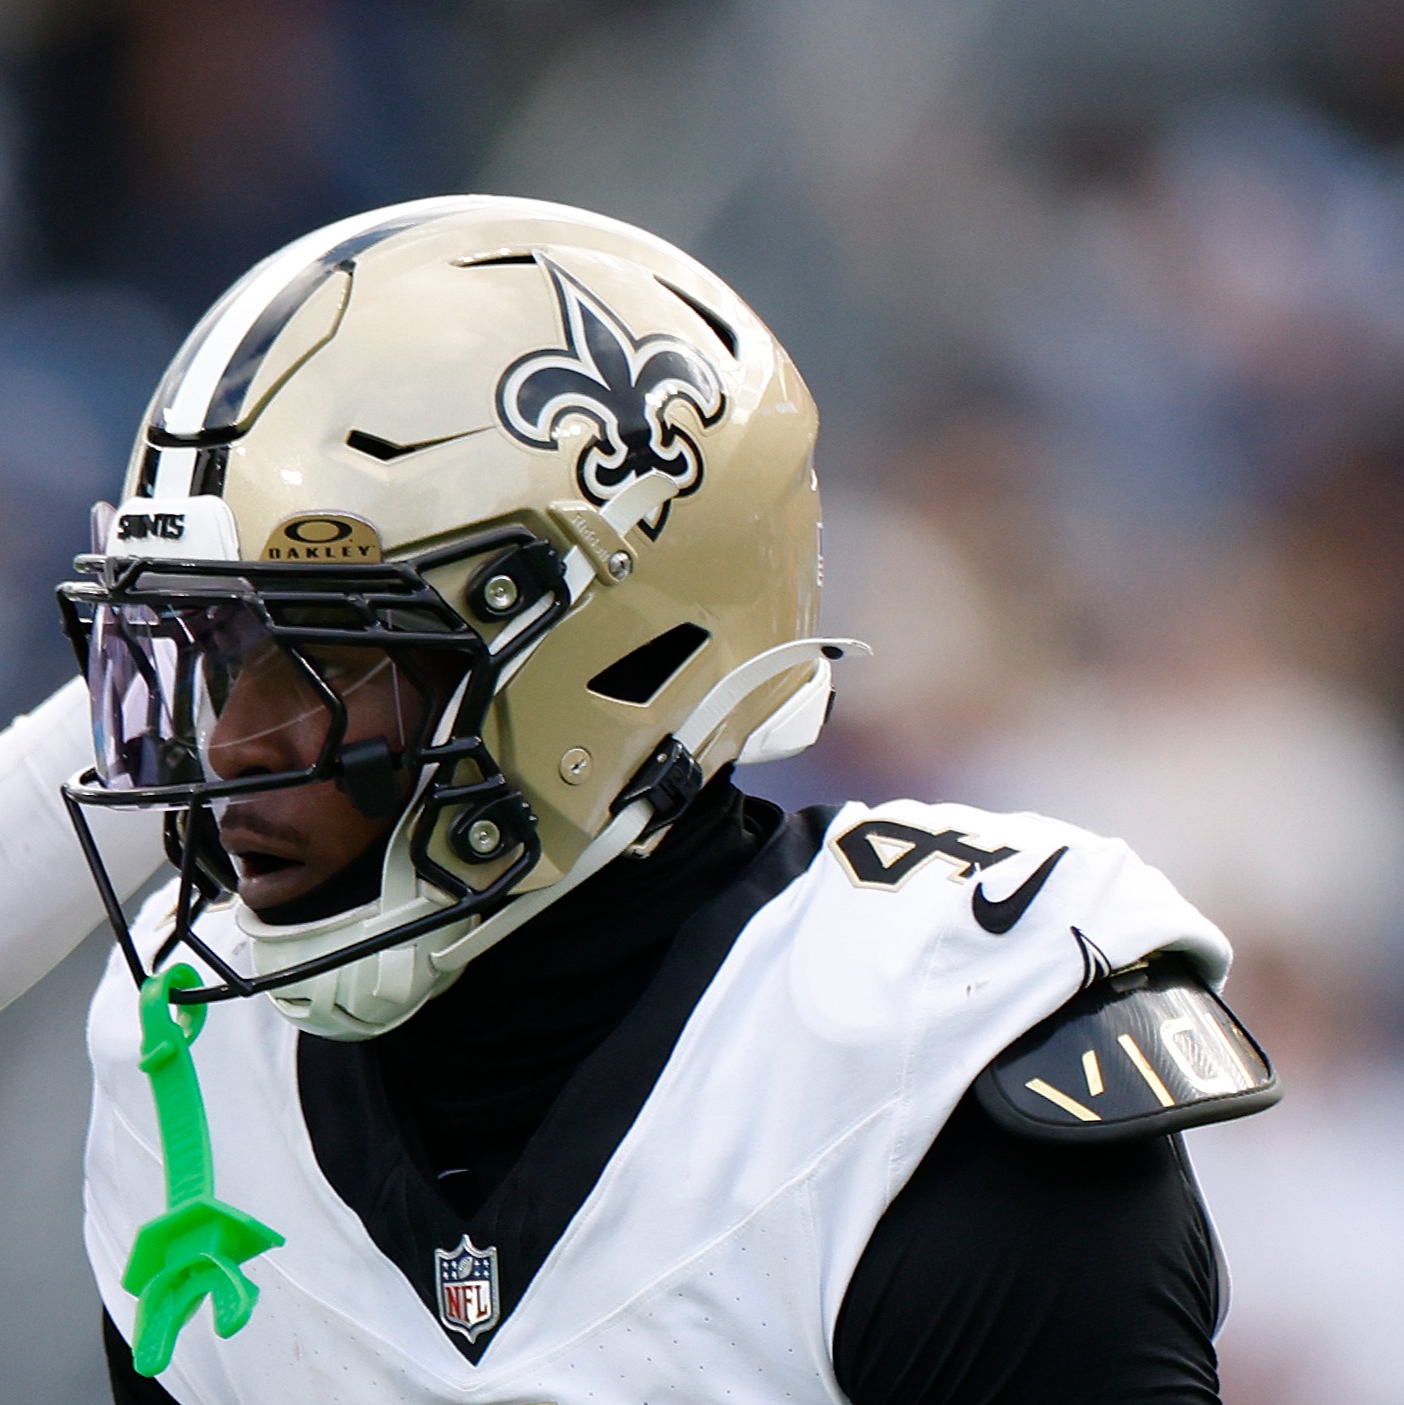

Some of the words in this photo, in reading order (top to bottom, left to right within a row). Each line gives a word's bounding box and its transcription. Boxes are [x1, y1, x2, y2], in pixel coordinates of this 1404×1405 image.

[268, 546, 373, 561] OAKLEY
[827, 817, 1021, 893] 4
[444, 1284, 489, 1324] NFL
